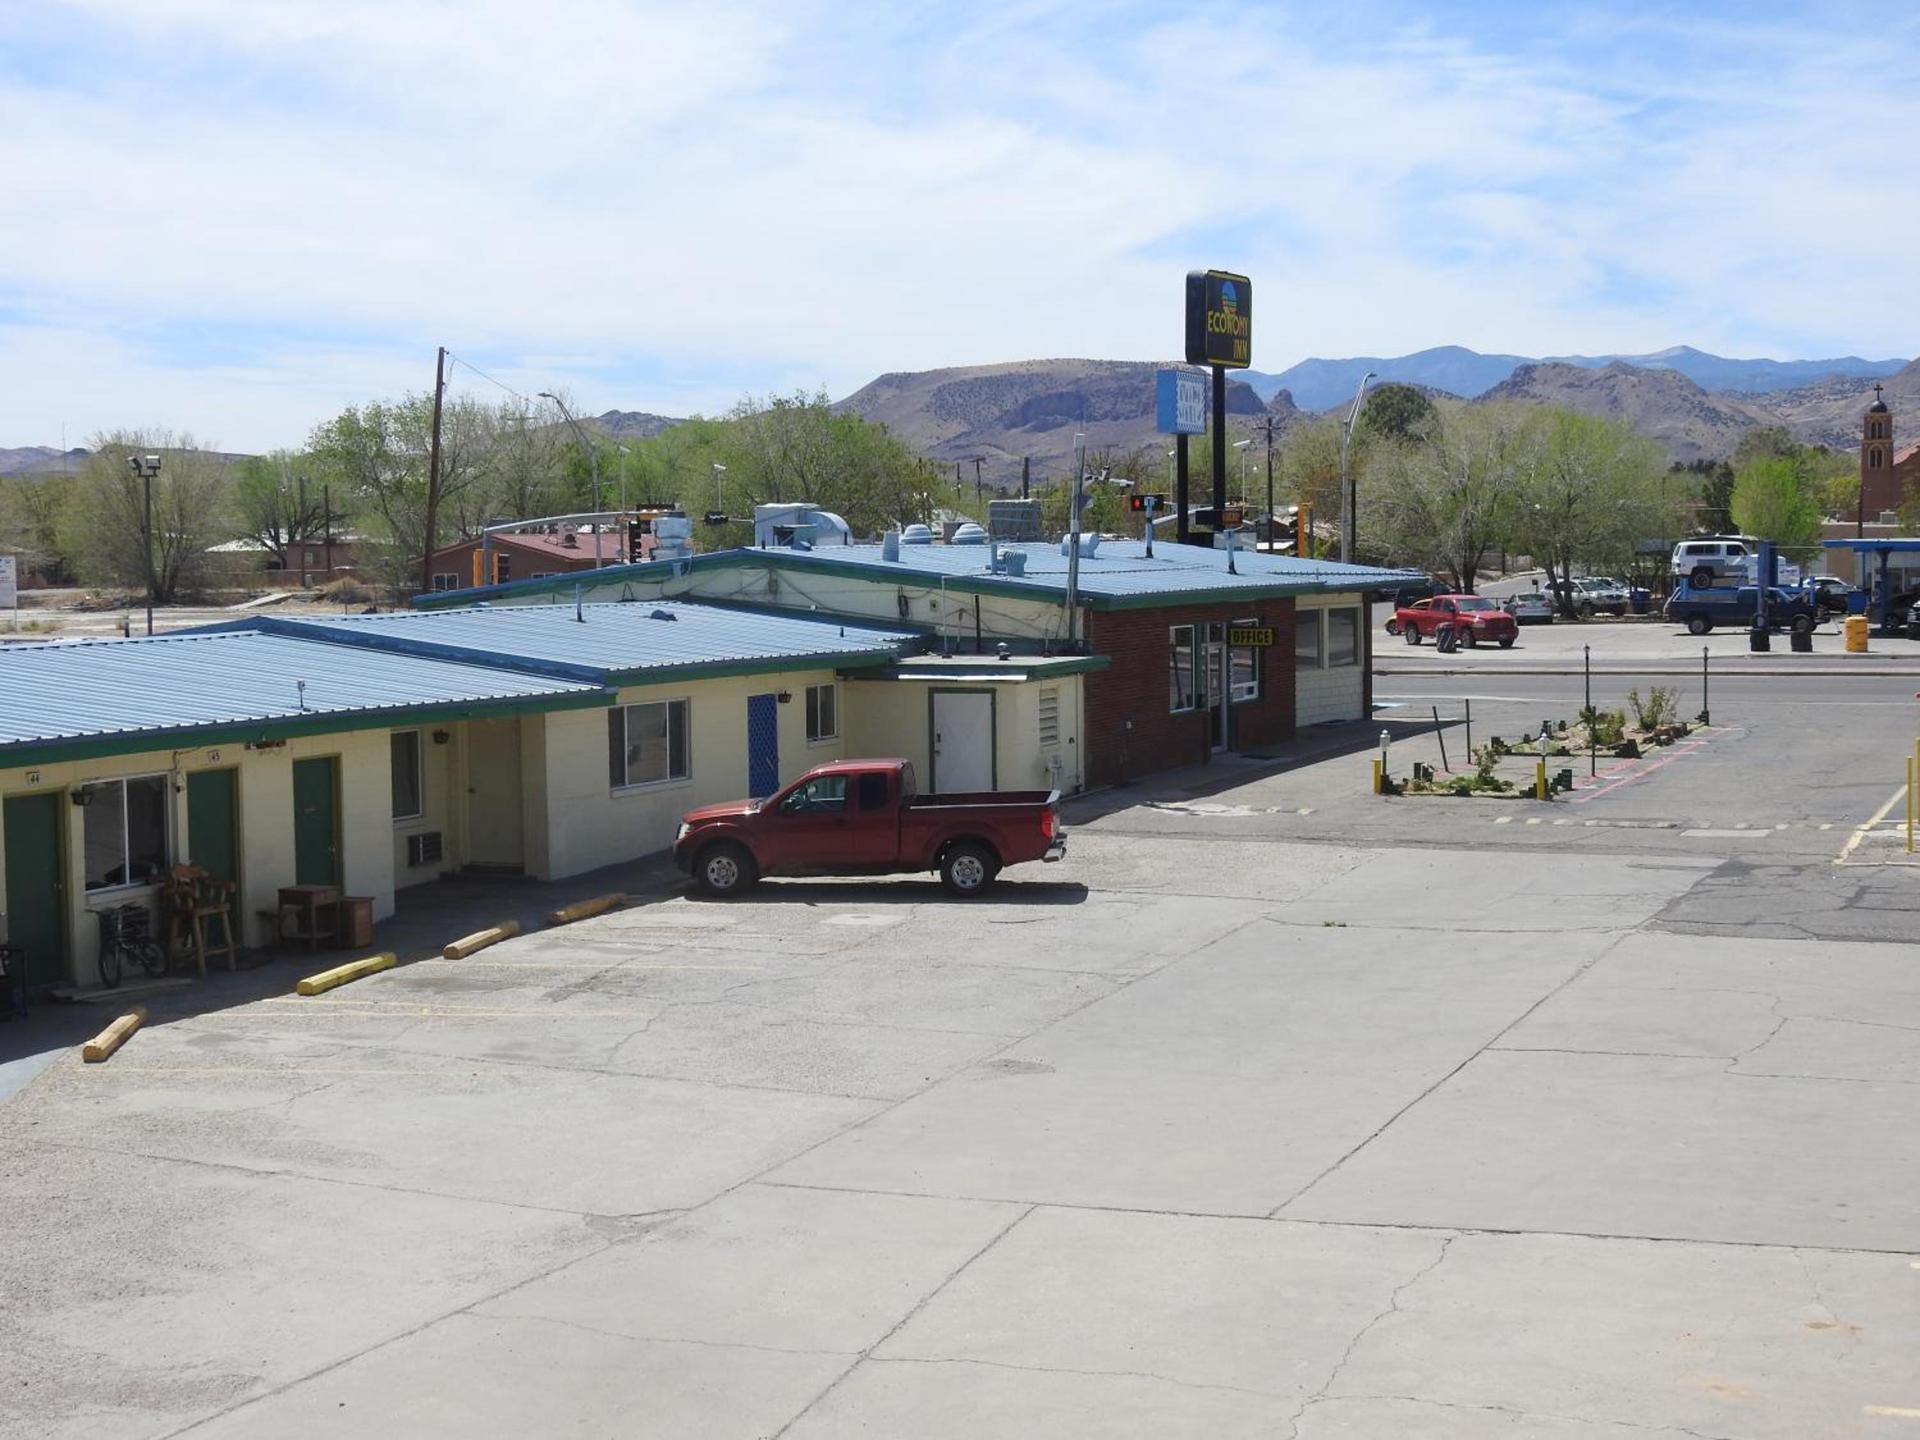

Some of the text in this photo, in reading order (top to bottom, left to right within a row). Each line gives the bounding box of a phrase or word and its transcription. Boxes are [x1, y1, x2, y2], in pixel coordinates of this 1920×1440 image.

[1207, 310, 1249, 337] ECONOMY
[1233, 338, 1249, 360] INN
[1233, 631, 1270, 643] OFFICE
